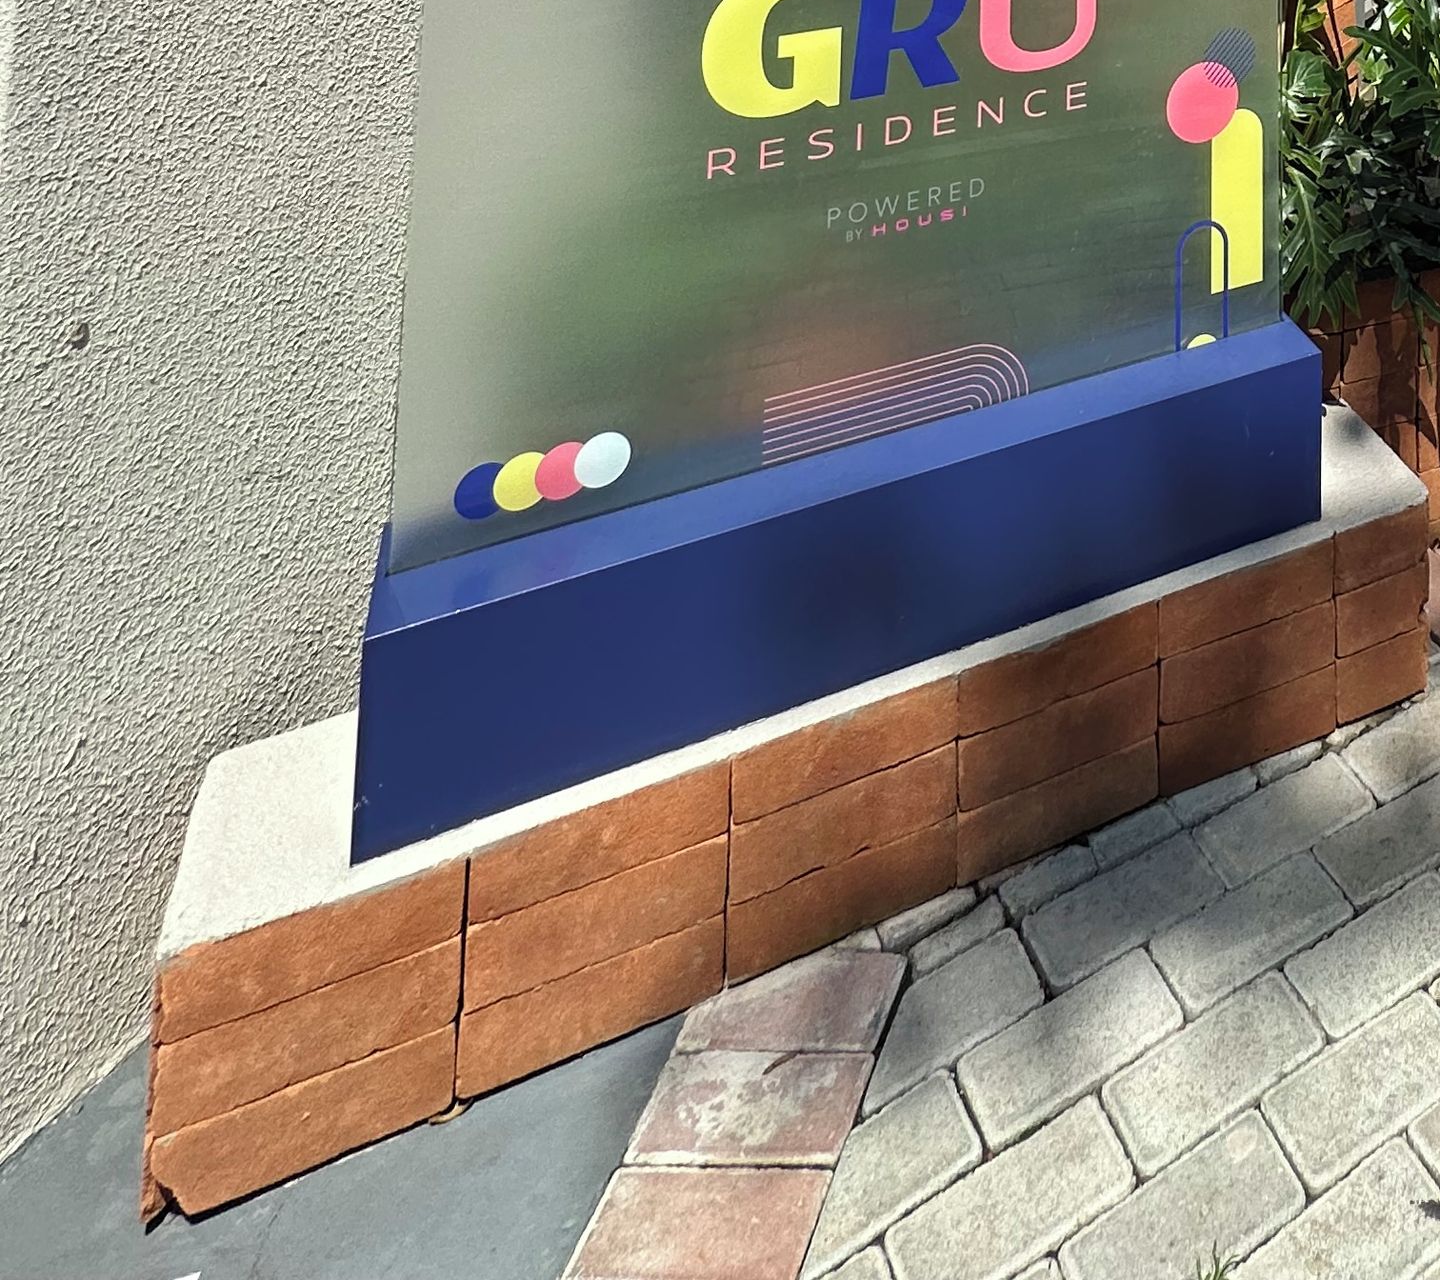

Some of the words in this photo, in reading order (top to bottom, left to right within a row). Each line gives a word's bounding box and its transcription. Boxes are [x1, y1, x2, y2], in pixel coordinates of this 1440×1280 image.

[706, 81, 1089, 180] RESIDENCE
[826, 178, 986, 229] POWERED
[845, 227, 863, 243] BY
[872, 205, 968, 237] HOUSI
